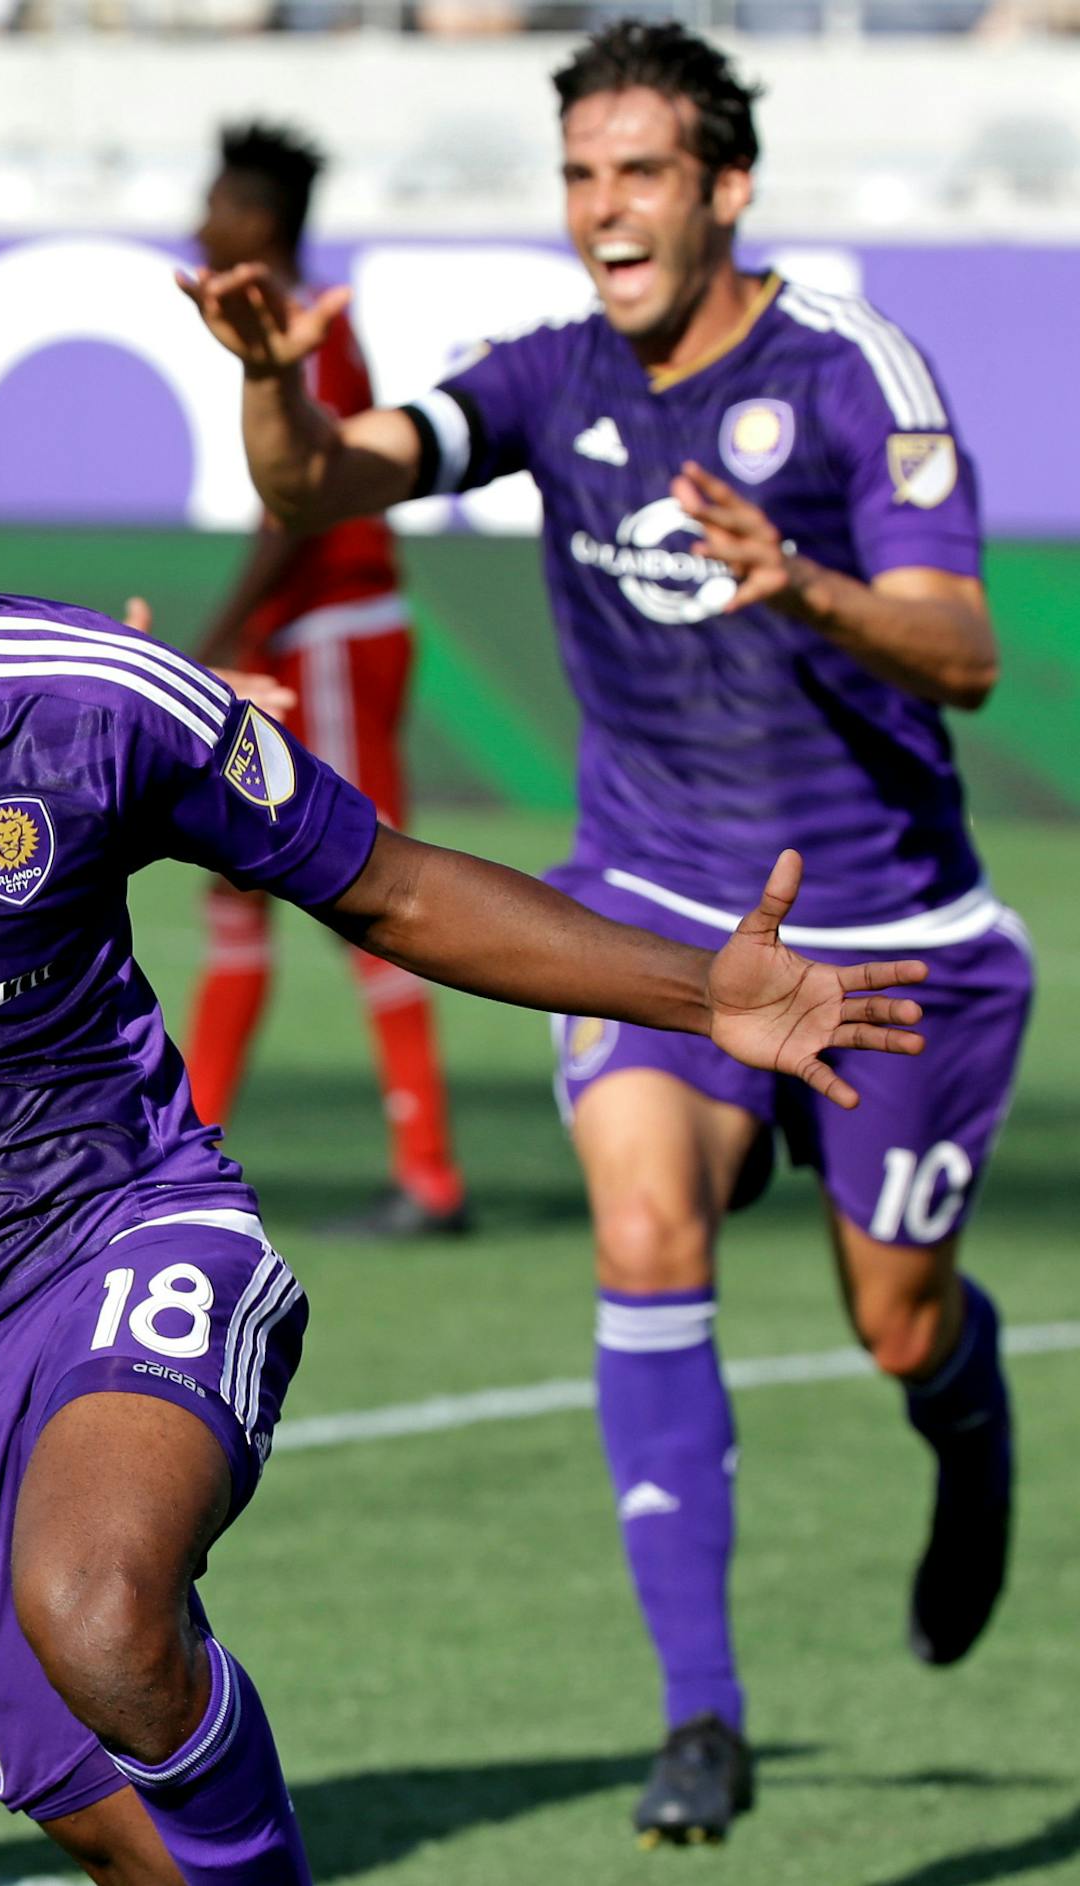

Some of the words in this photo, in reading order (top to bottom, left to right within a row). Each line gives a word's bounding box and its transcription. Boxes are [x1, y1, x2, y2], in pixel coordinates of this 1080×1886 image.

[231, 738, 255, 782] MLS
[5, 879, 30, 894] CITY
[869, 1139, 973, 1244] 10
[90, 1262, 215, 1359] 18
[132, 1359, 207, 1399] adidas
